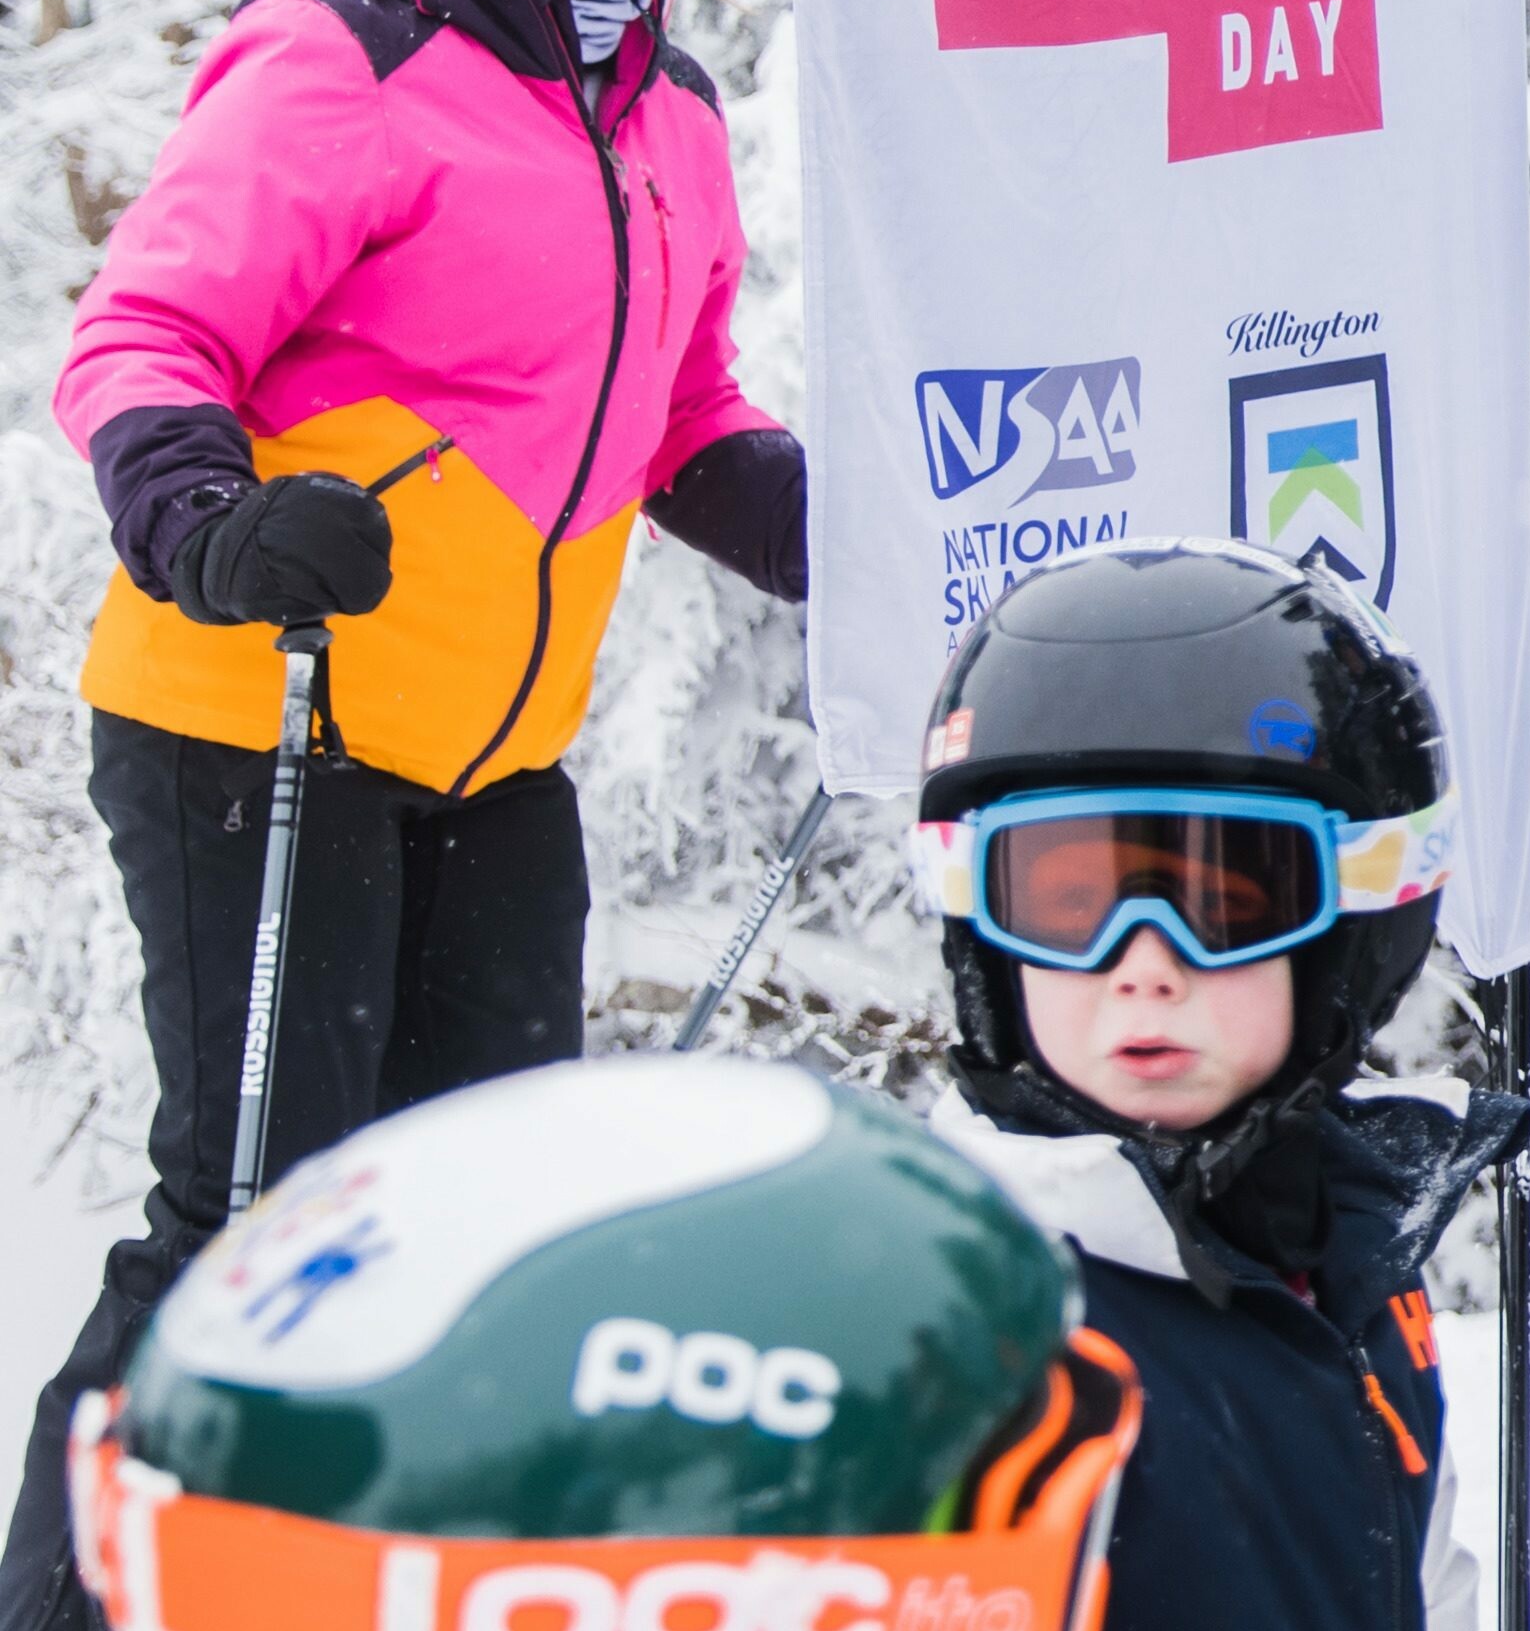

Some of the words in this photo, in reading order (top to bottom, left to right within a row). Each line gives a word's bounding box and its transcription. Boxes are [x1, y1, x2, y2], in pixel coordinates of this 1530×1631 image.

[1221, 0, 1342, 91] DAY
[1226, 310, 1383, 358] Killington
[916, 360, 1141, 506] NSAA
[709, 855, 795, 991] ROSSIGNOL
[240, 912, 281, 1097] ROSSIGNOL
